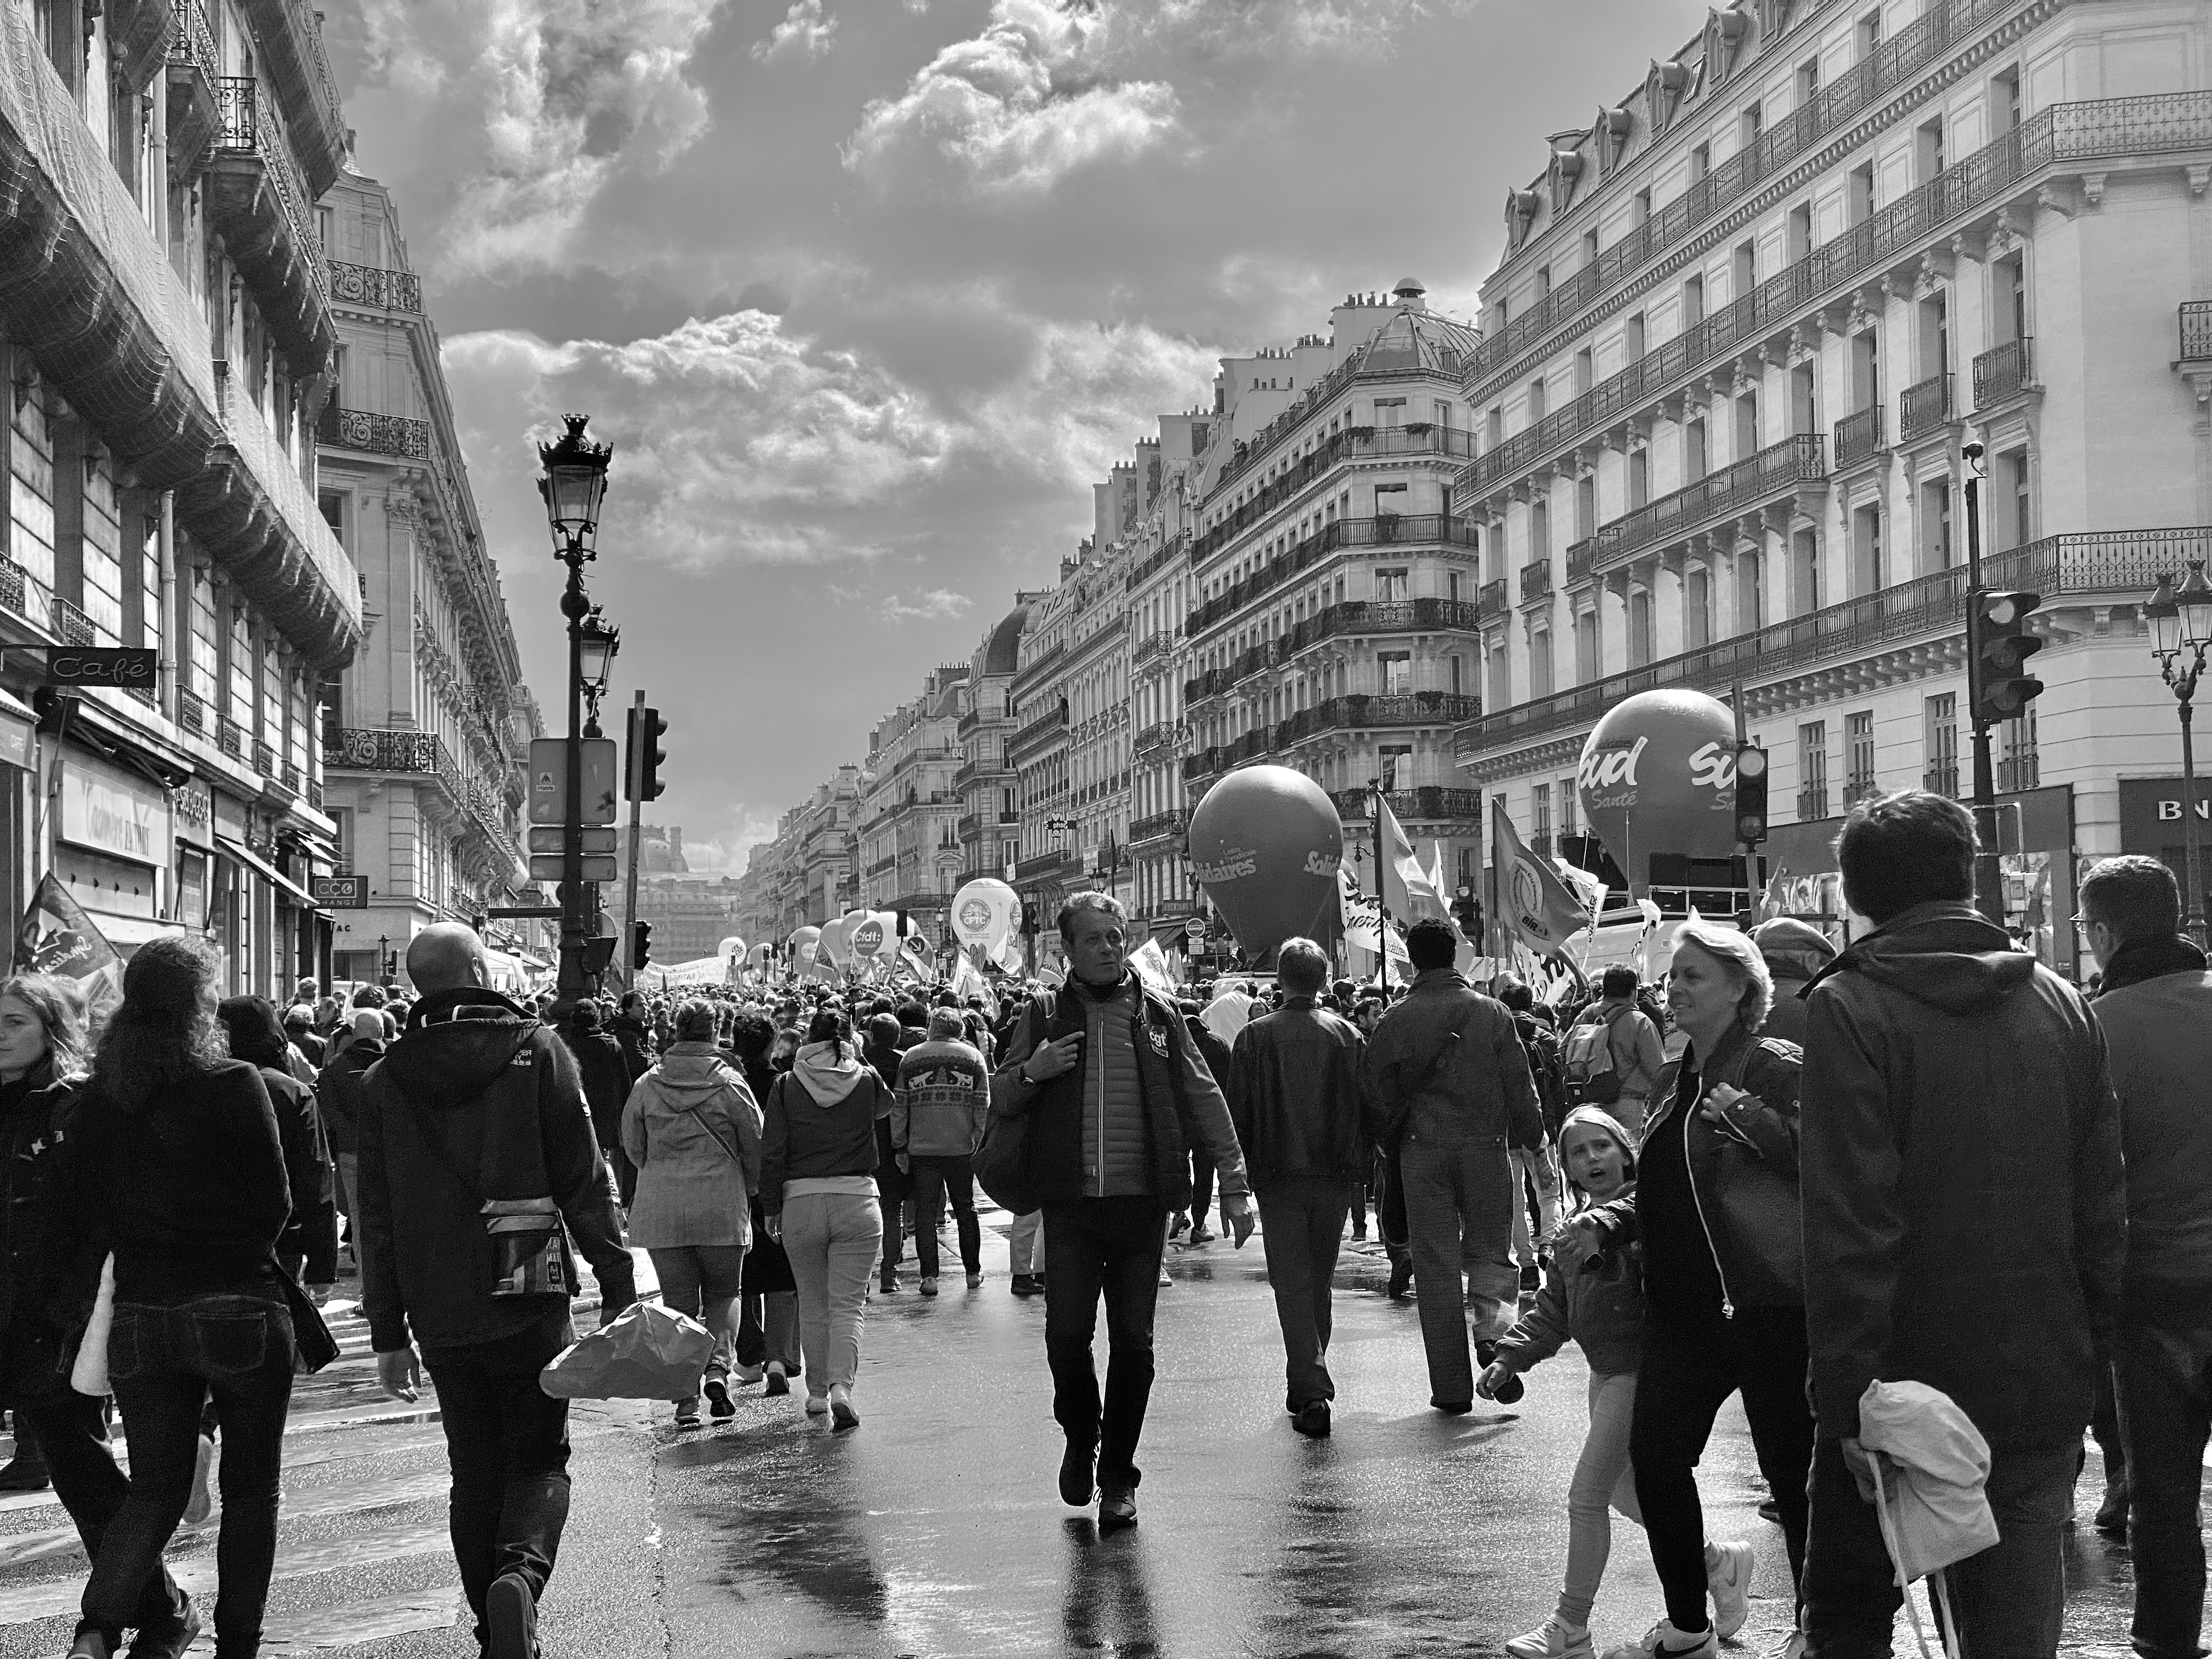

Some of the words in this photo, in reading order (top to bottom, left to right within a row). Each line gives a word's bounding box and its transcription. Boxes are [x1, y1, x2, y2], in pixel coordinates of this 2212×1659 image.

[53, 658, 148, 683] Café
[1592, 790, 1638, 809] Santé
[1224, 849, 1256, 863] Syndicale
[963, 917, 986, 925] CFTC
[1149, 1031, 1166, 1047] cgt
